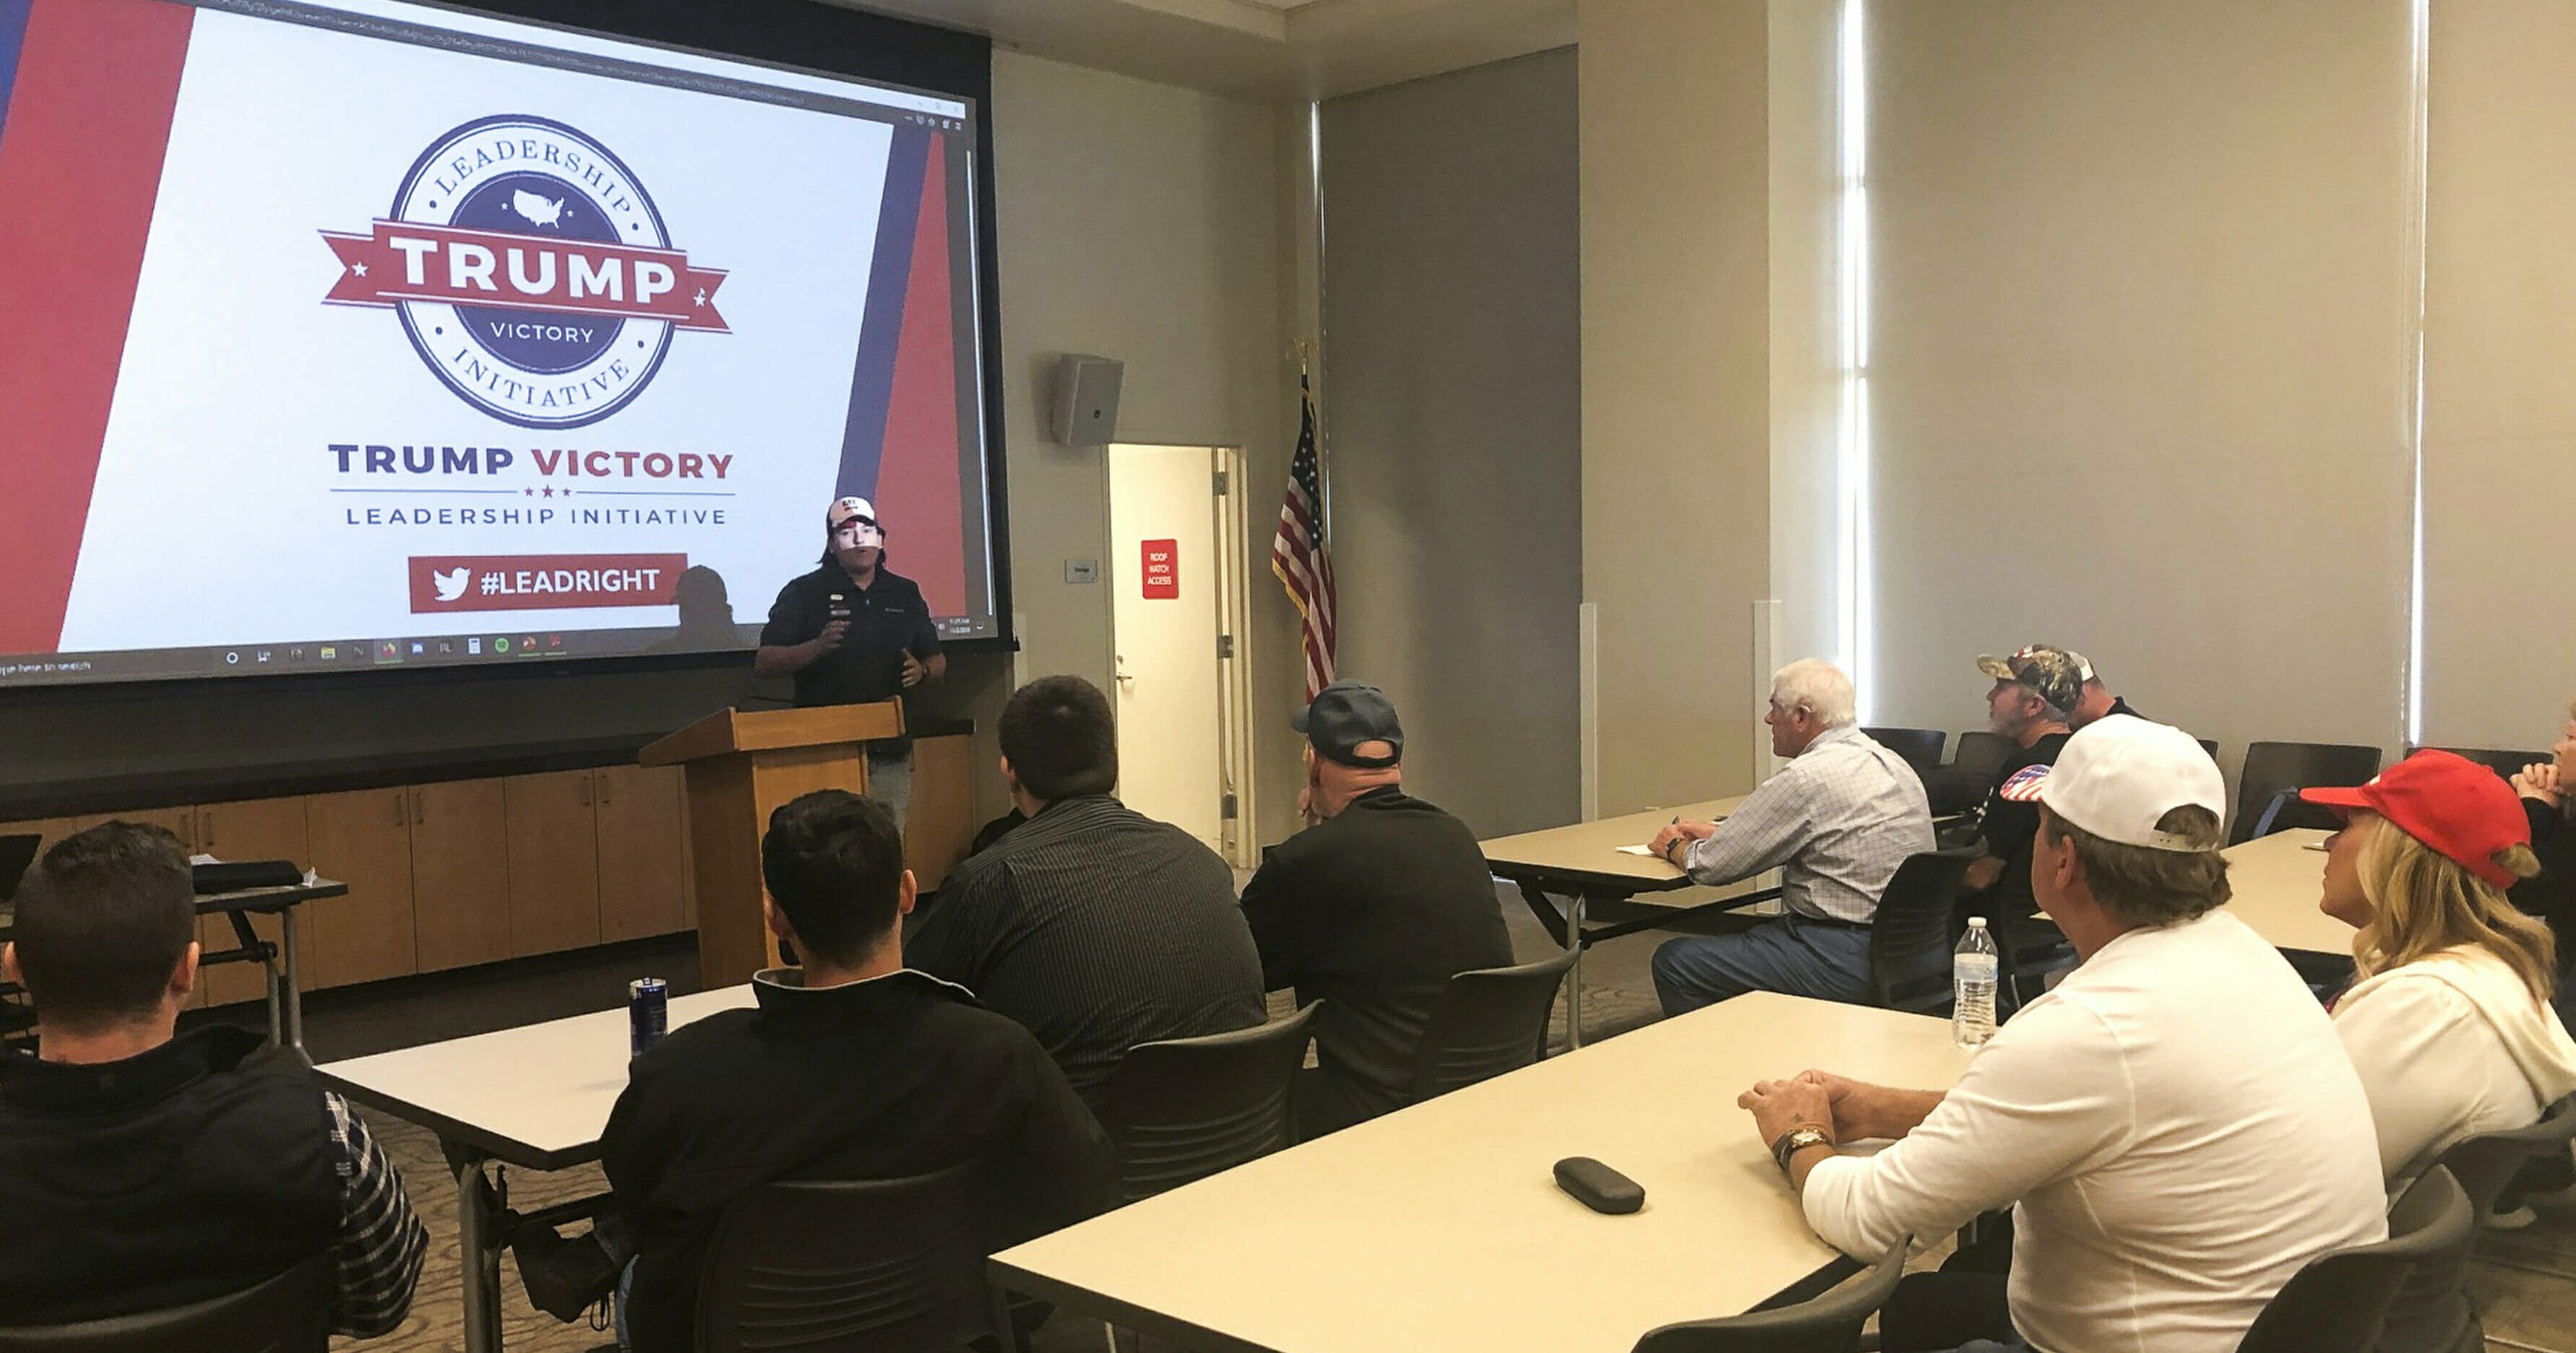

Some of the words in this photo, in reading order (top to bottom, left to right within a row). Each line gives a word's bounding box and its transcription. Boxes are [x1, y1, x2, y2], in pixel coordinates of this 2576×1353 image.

[435, 140, 631, 214] LEADERSHIP
[389, 236, 676, 305] TRUMP
[490, 322, 594, 344] VICTORY
[452, 348, 629, 409] INITIATIVE
[328, 444, 514, 475] TRUMP
[531, 449, 734, 479] VICTORY
[346, 508, 554, 525] LEADERSHIP
[572, 509, 726, 525] INITIATIVE
[1149, 552, 1168, 562] ROOF
[481, 569, 660, 596] #LEADRIGHT
[1148, 576, 1172, 586] ACCESS
